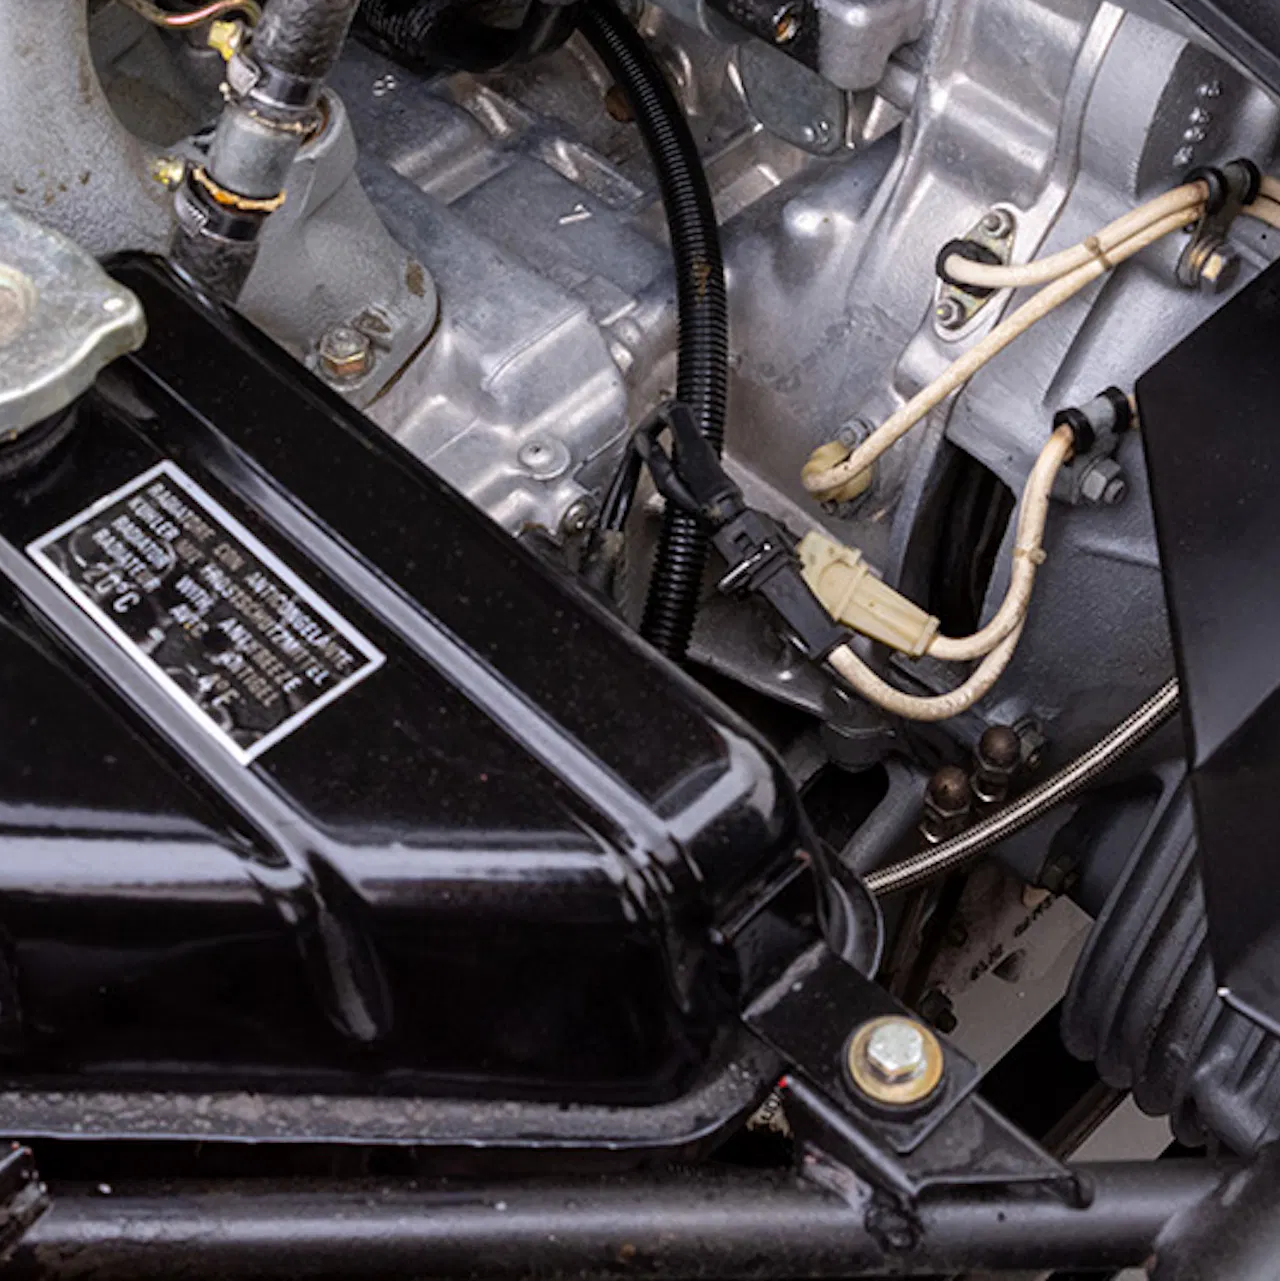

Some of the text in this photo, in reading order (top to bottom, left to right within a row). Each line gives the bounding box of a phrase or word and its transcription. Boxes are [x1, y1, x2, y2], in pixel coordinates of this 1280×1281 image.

[90, 526, 281, 706] RADIATEUR AVEC ANTIGEL
[109, 514, 302, 693] RADIATOR WITH ANTIFREEZE
[144, 480, 355, 670] RADIATORE CON ANTICONGELANTE
